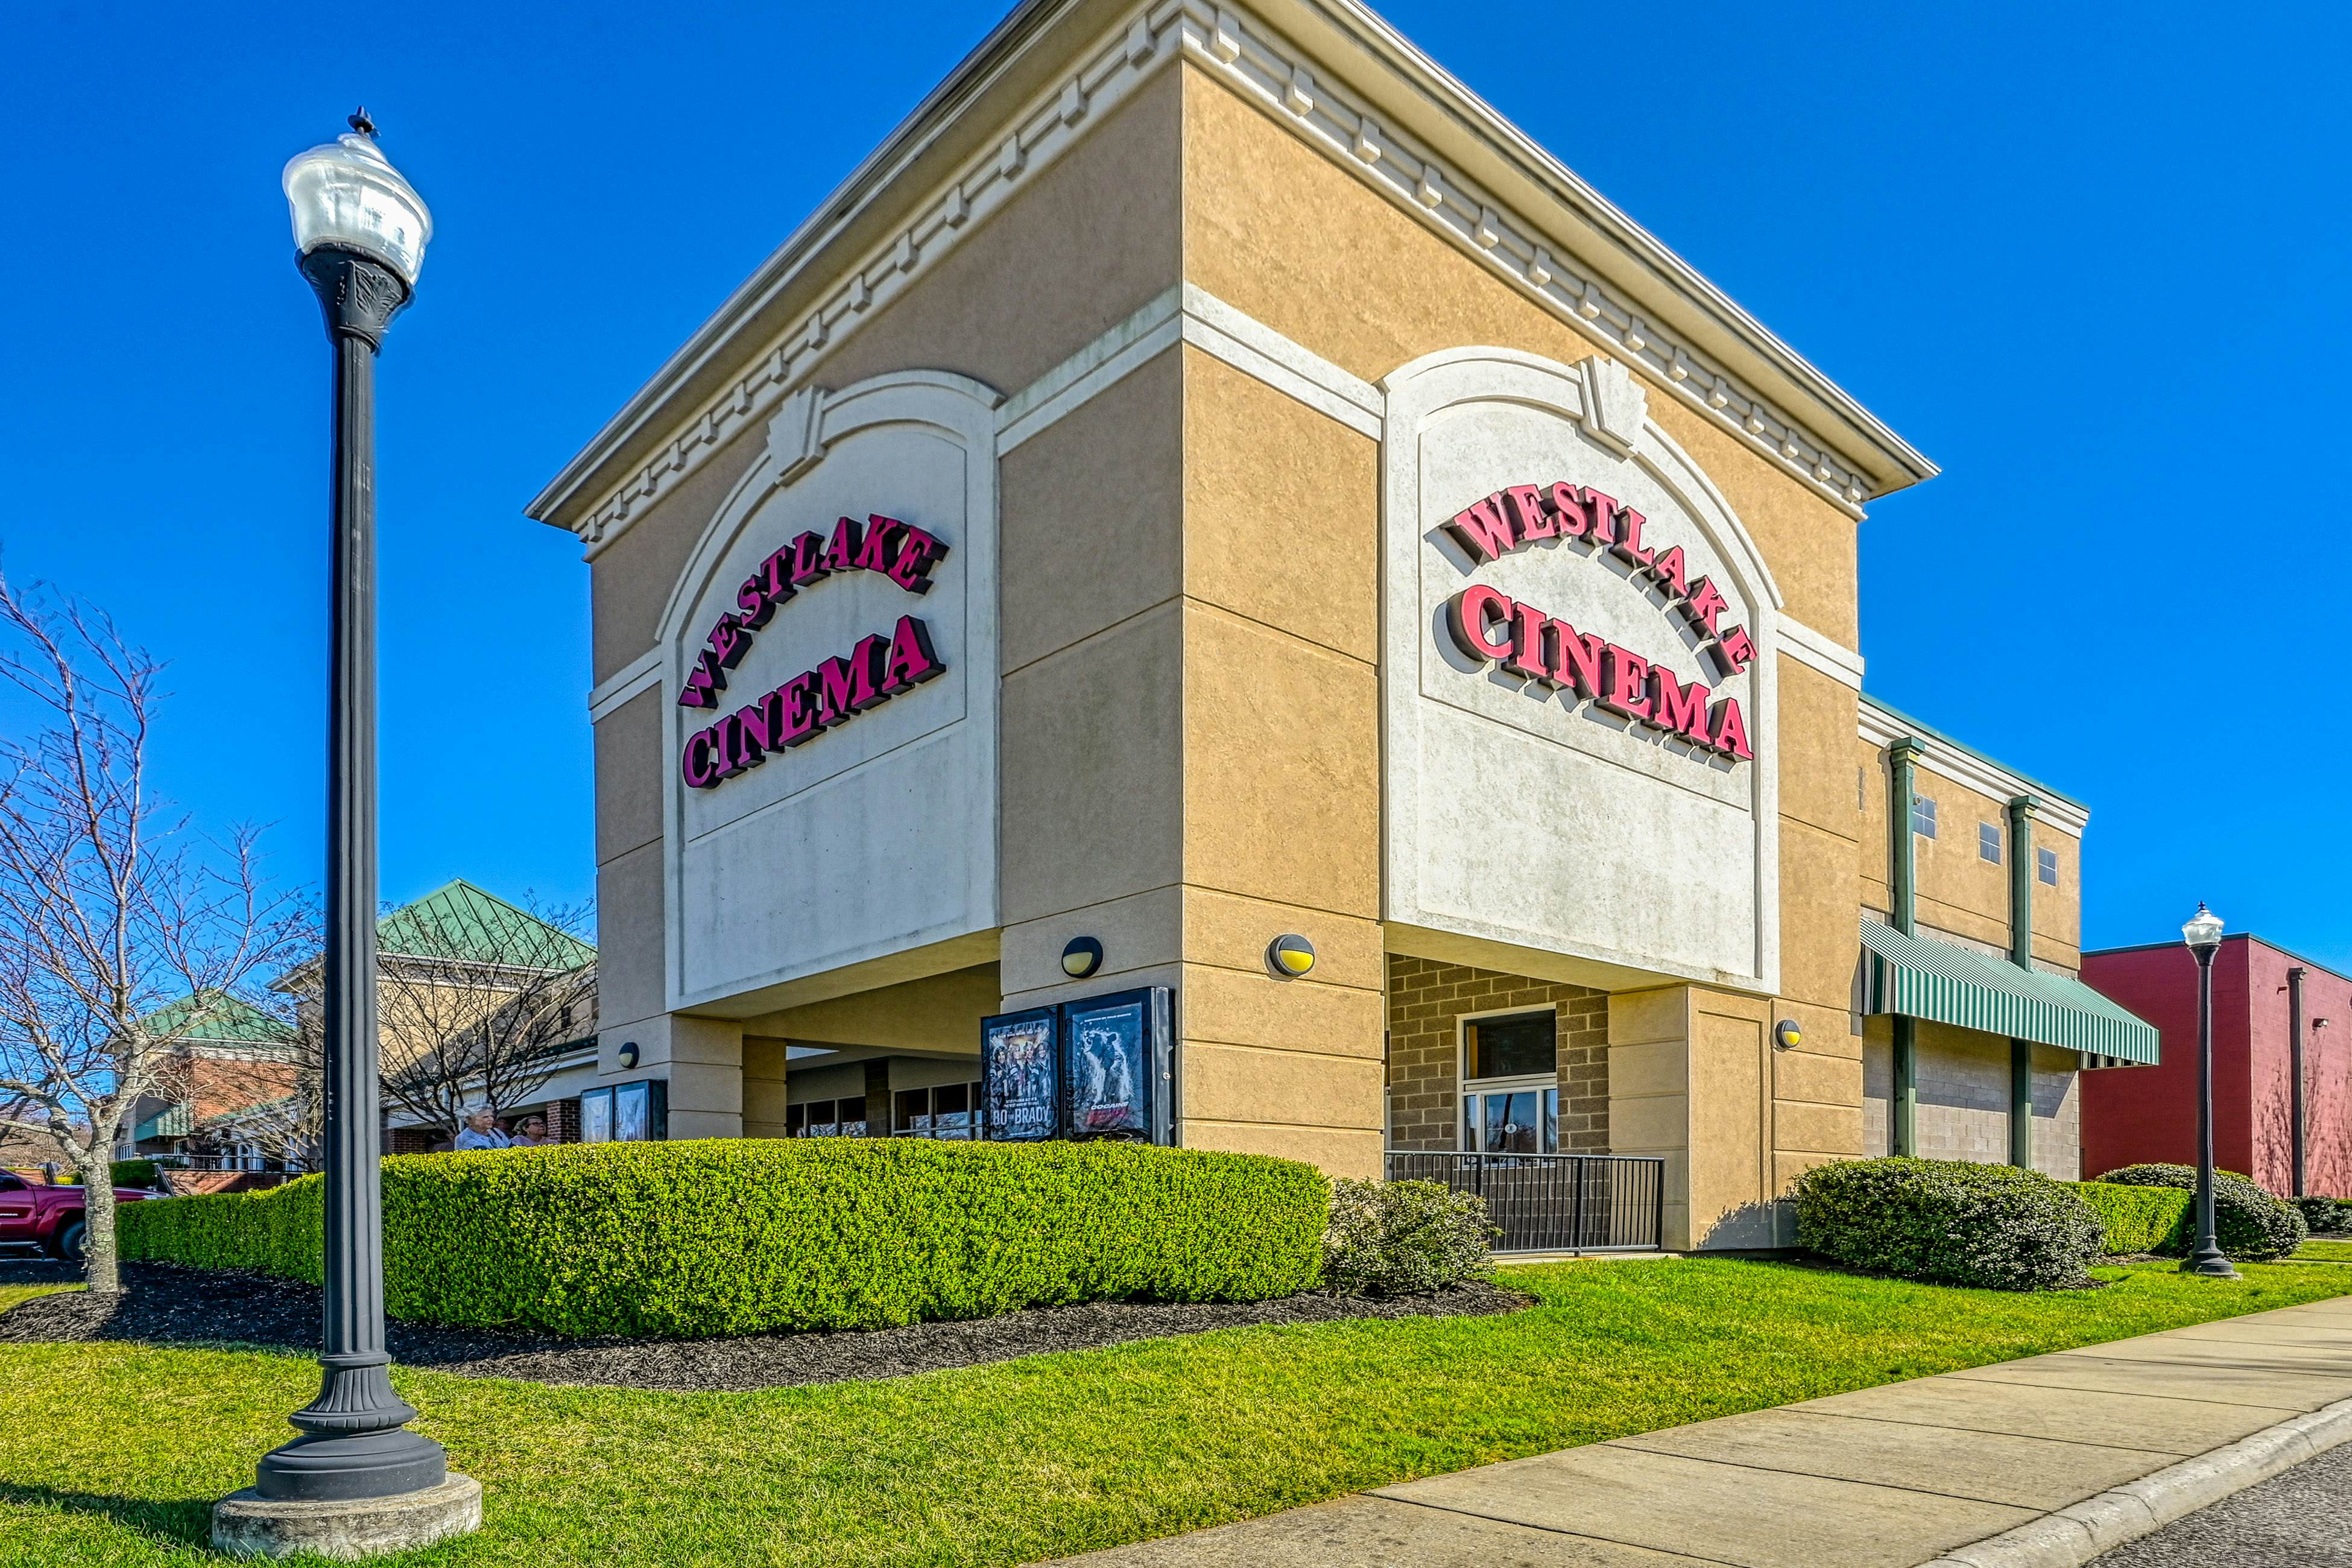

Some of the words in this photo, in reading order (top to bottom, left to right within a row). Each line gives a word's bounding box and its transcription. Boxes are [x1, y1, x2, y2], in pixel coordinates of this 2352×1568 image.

[678, 513, 942, 708] WESTLAKE
[1454, 482, 1757, 674] WESTLAKE
[683, 615, 938, 788] CINEMA
[1461, 584, 1754, 760] CINEMA
[1014, 1105, 1049, 1124] BRADY
